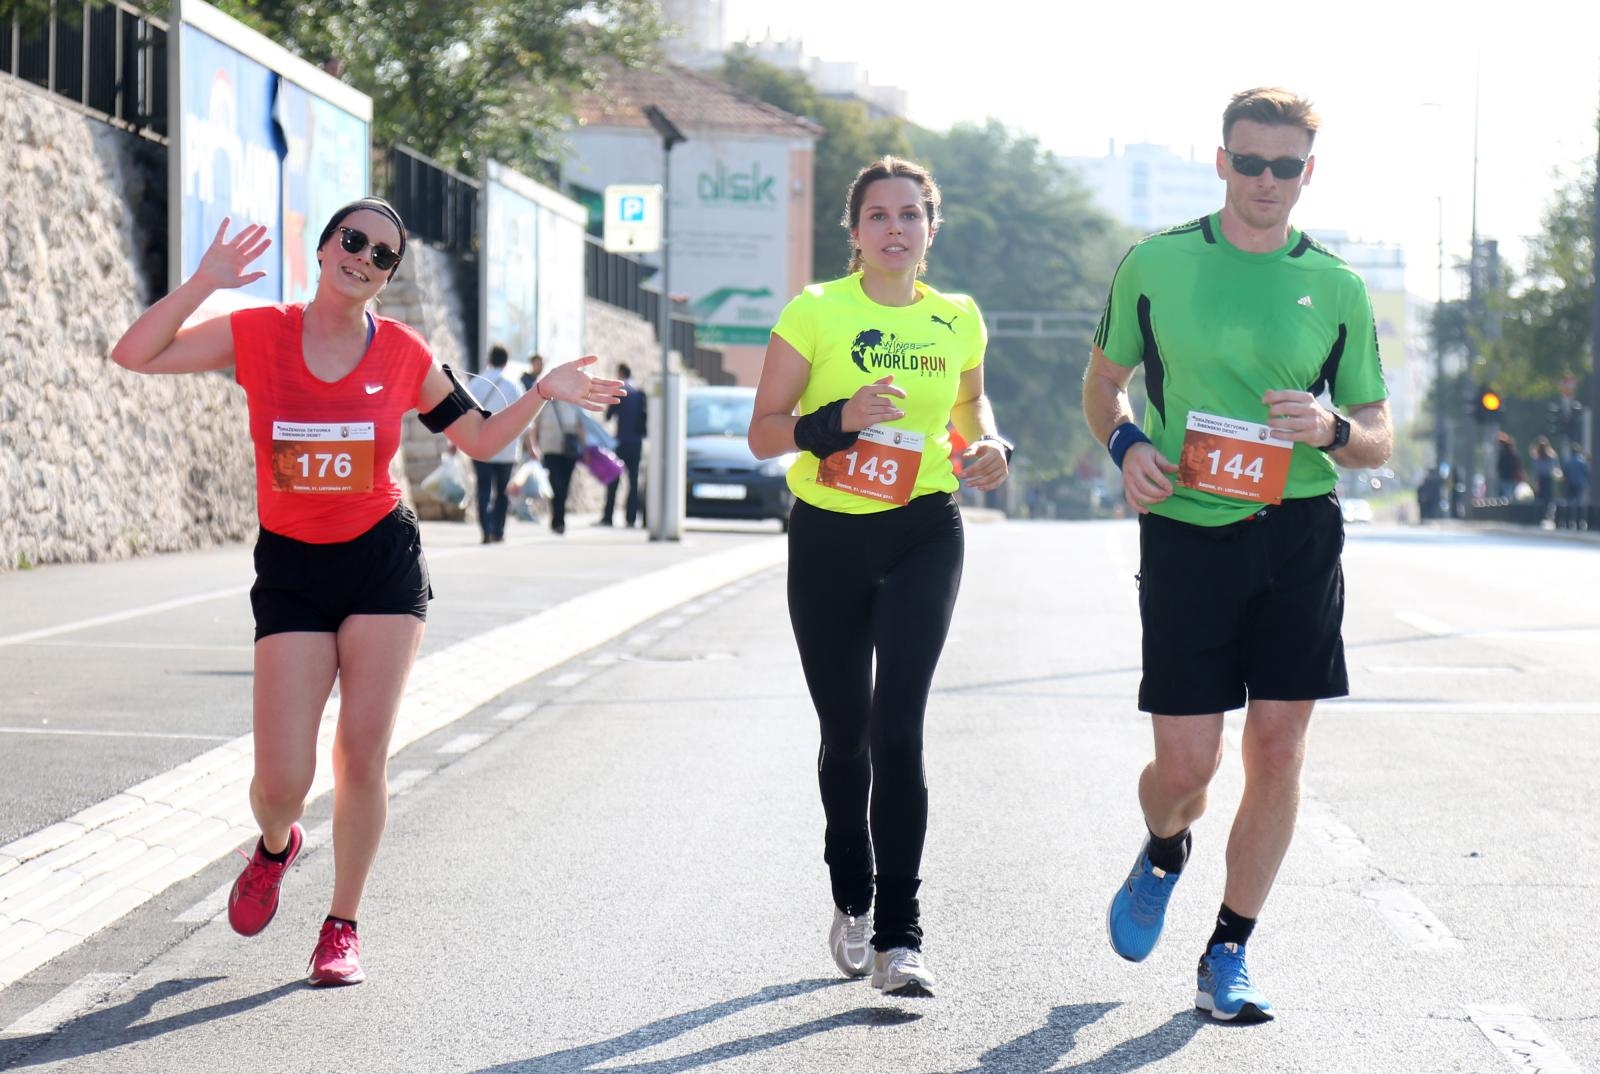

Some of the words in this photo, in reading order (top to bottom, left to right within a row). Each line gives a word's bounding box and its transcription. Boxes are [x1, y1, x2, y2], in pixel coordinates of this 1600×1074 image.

[624, 198, 642, 220] P
[870, 352, 919, 371] WORLD
[920, 356, 946, 372] RUN
[296, 453, 352, 478] 176
[845, 451, 899, 485] 143
[1207, 449, 1264, 484] 144
